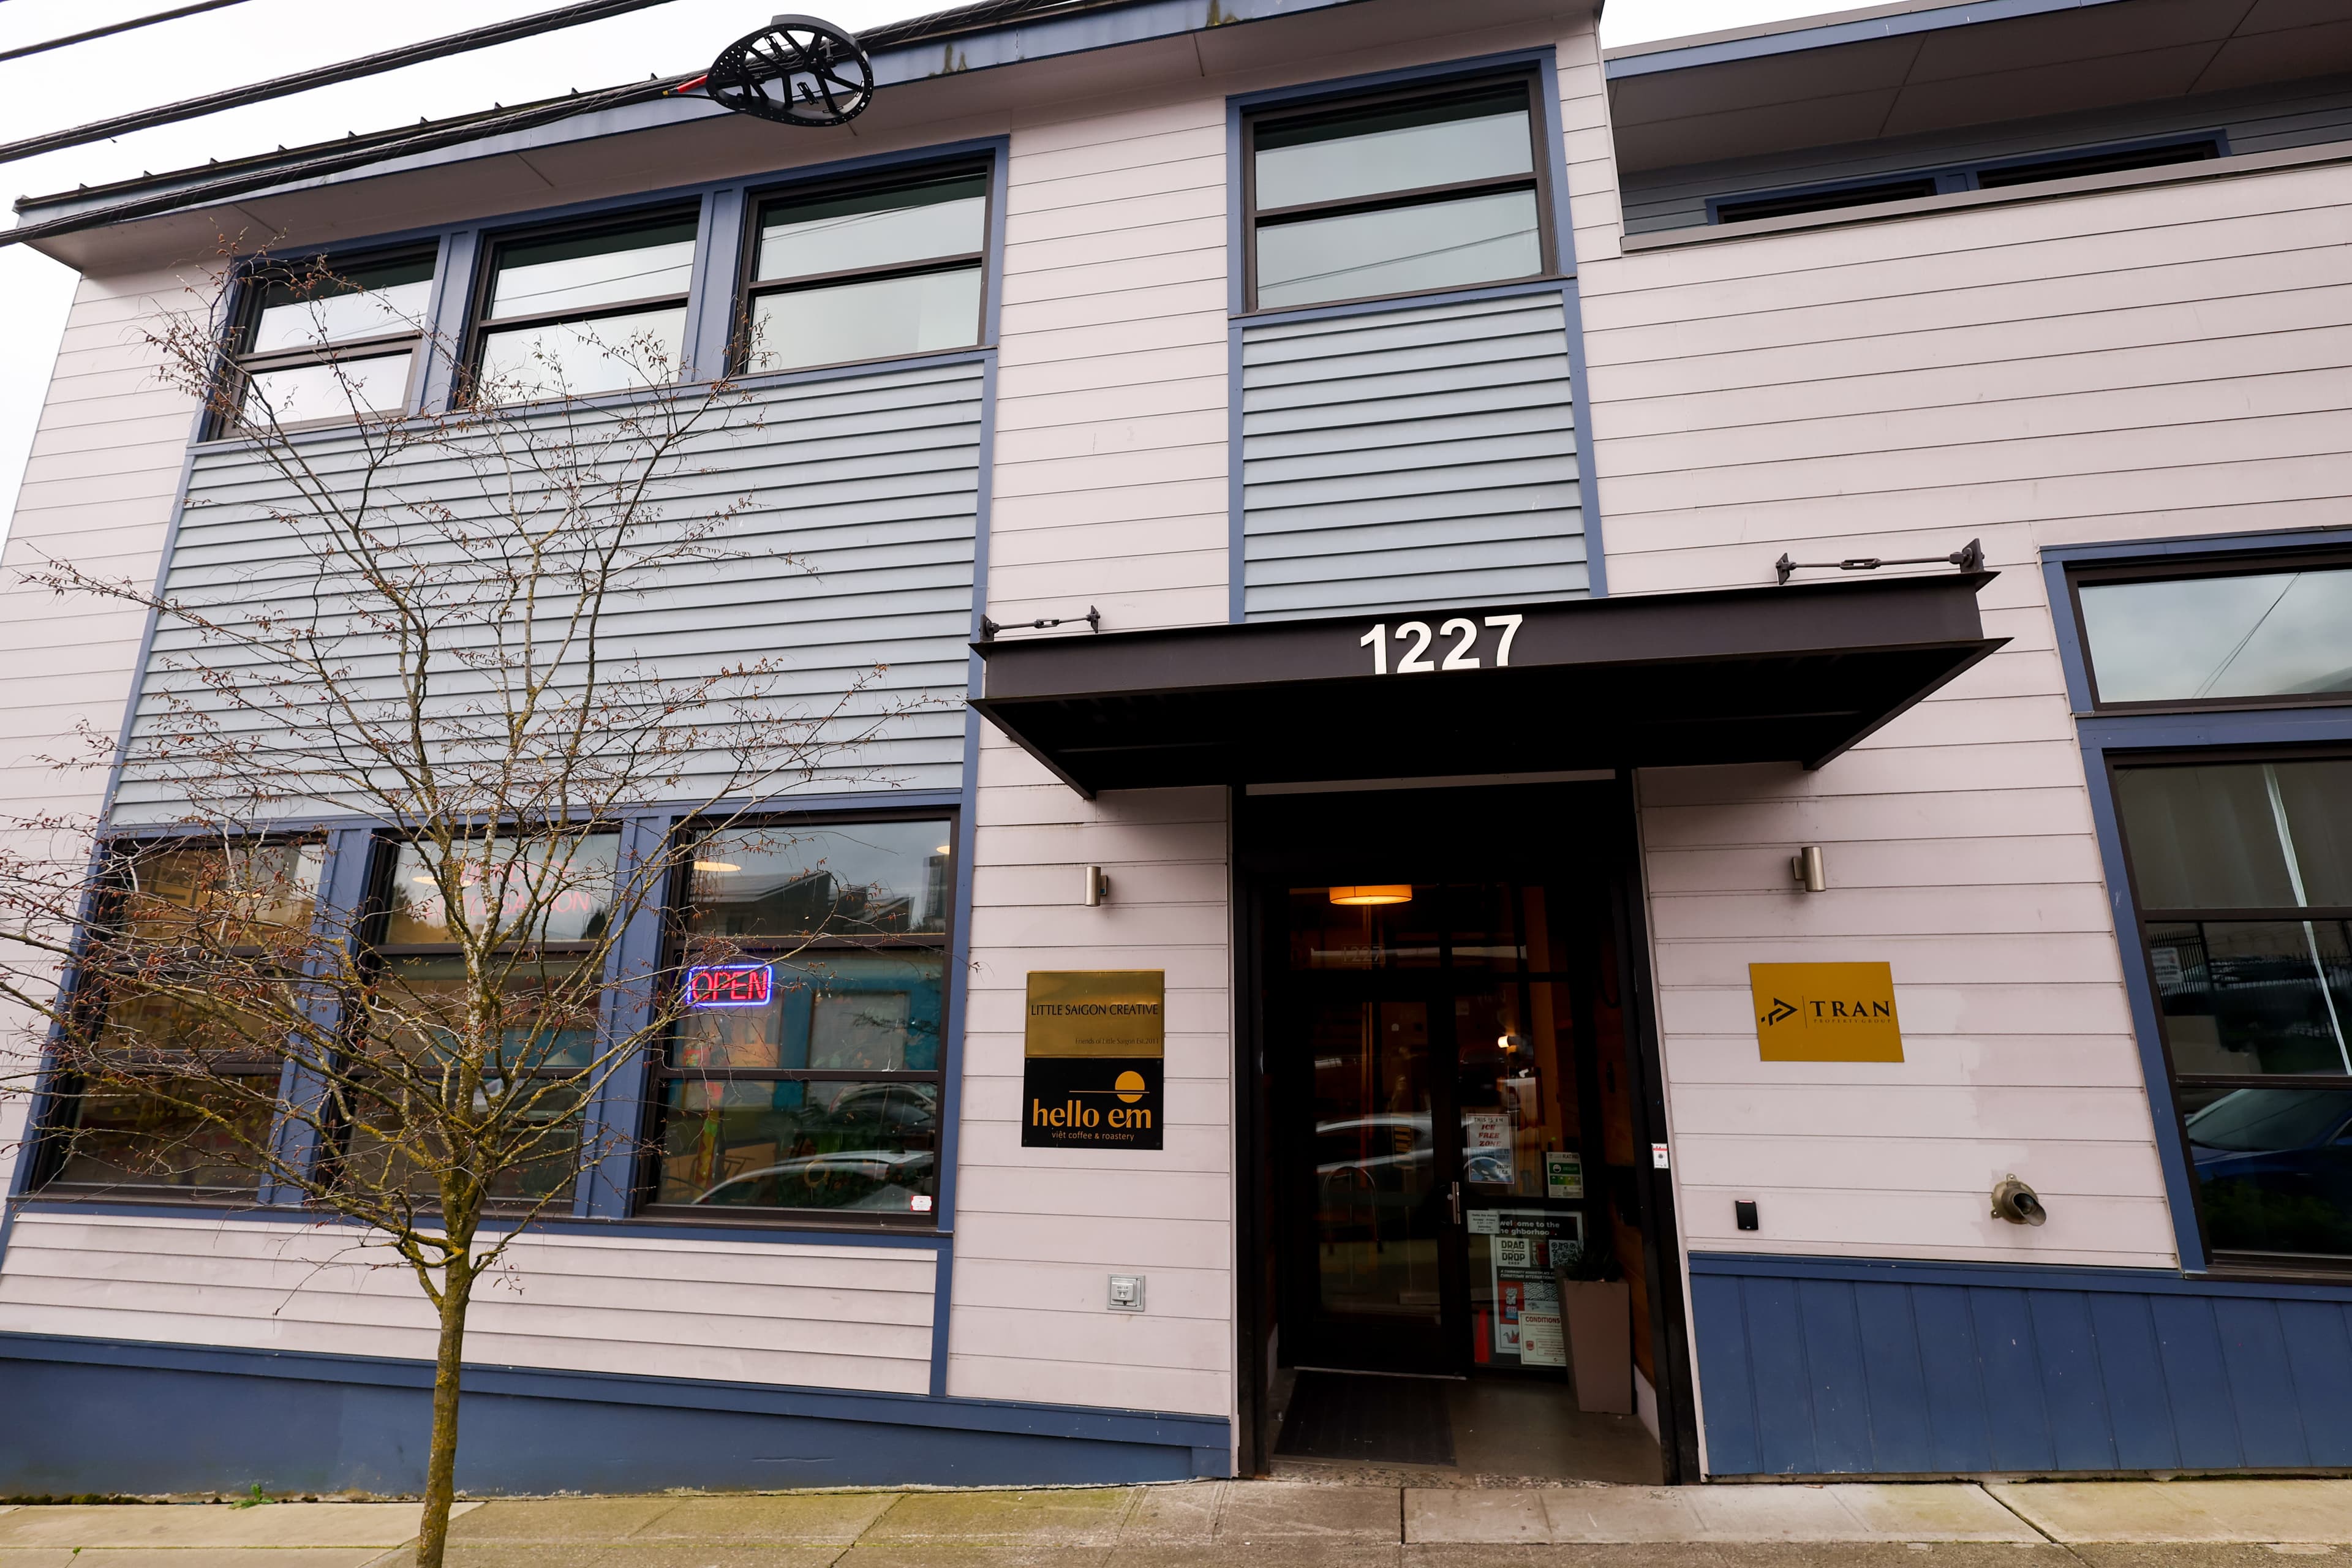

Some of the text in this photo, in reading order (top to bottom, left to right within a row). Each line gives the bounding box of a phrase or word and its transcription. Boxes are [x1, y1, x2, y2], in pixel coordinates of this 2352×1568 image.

[1360, 614, 1523, 675] 1227
[1343, 946, 1382, 962] 1227
[692, 971, 768, 1000] OPEN
[1031, 1003, 1158, 1016] LITTLE SAIGON CREATIVE
[1810, 1000, 1890, 1017] TRAN
[1033, 1098, 1152, 1128] hello em
[1068, 1131, 1092, 1139] coffee
[1102, 1133, 1135, 1142] roastery
[1501, 1240, 1525, 1250] DRAG
[1502, 1253, 1526, 1262] DROP
